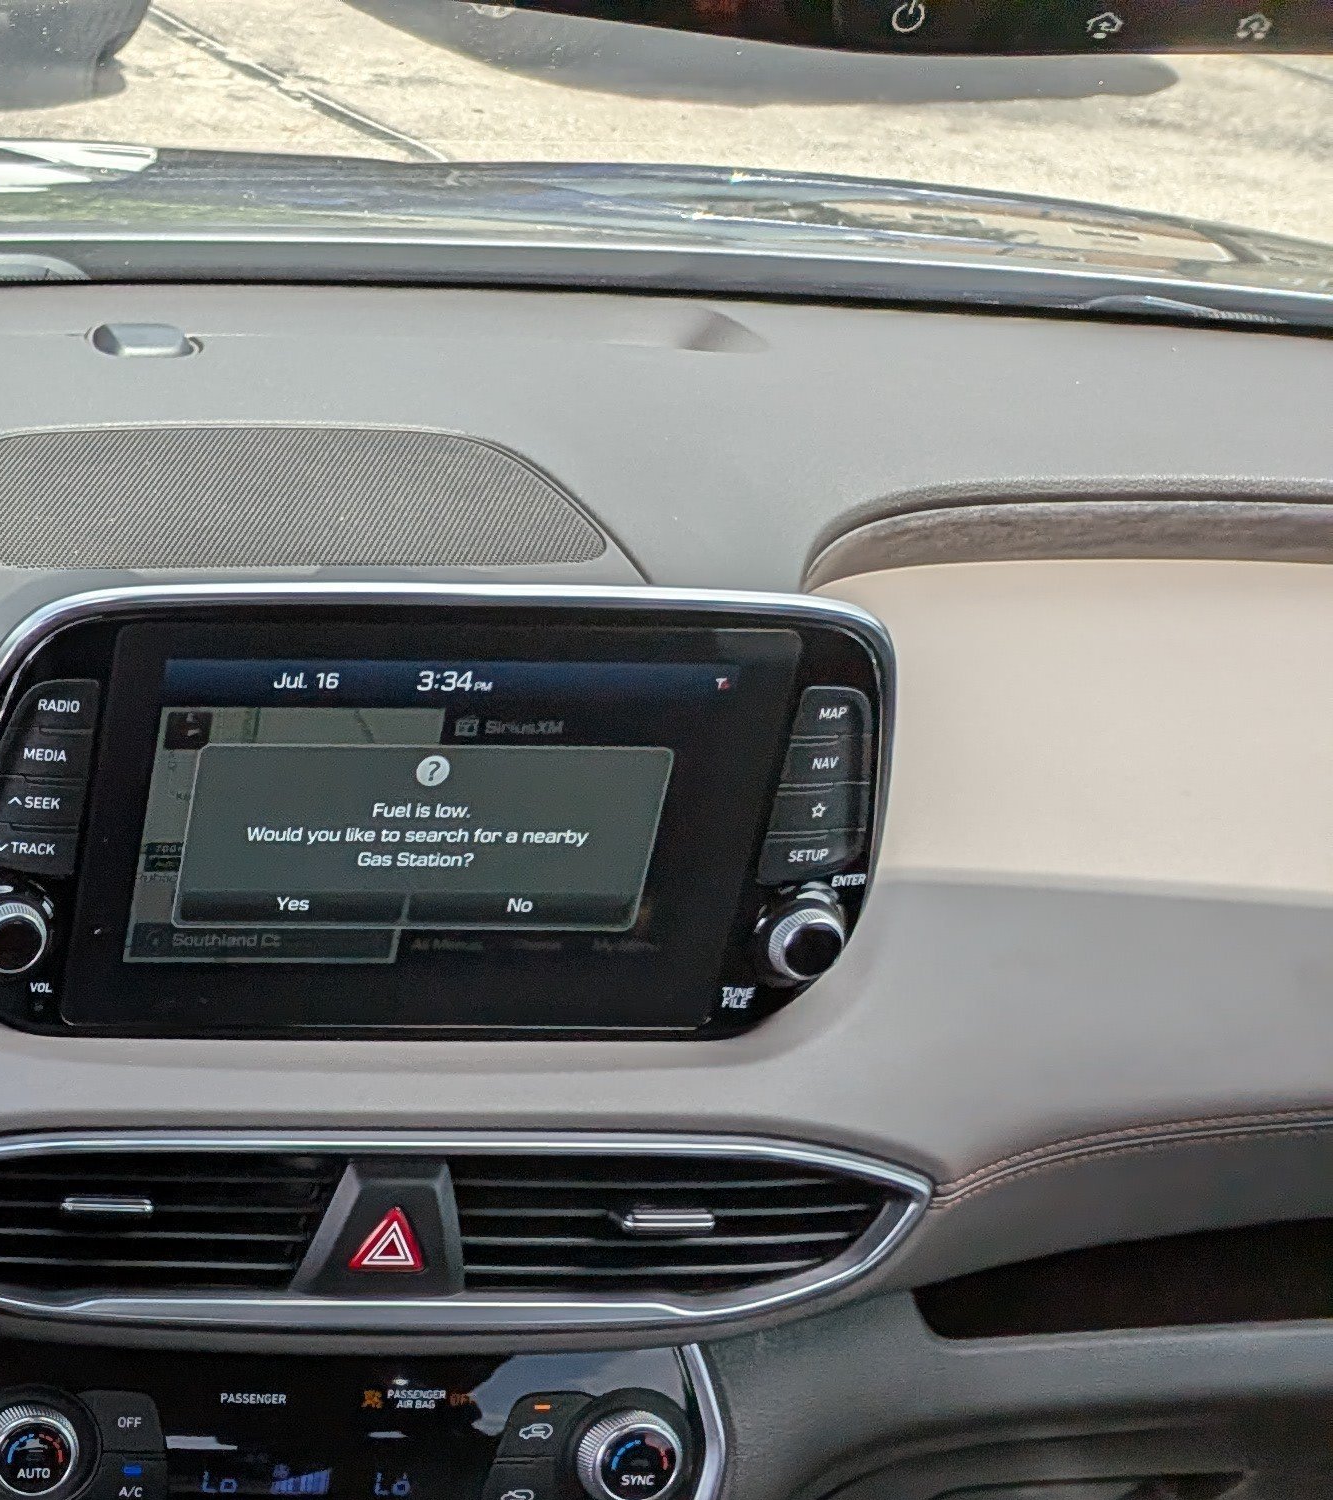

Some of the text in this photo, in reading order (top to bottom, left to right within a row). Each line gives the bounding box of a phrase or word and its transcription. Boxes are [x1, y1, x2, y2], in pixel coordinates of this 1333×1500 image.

[315, 673, 340, 689] 16
[37, 698, 81, 714] RADIO
[818, 707, 848, 720] MAP
[23, 747, 67, 763] MEDIA
[811, 756, 840, 771] NAV
[24, 796, 61, 810] SEEK
[372, 803, 472, 819] Fuel is low.
[246, 826, 590, 848] Would you like to search for a nearby
[11, 841, 56, 856] TRACK
[357, 851, 475, 868] Gas Station?
[787, 848, 830, 864] SETUP
[831, 873, 867, 887] ENTER
[276, 897, 310, 912] Yes
[506, 898, 533, 914] No
[29, 982, 53, 994] VOL
[721, 986, 755, 999] TUNE
[720, 997, 751, 1009] FILE
[219, 1392, 287, 1405] PASSENGER
[386, 1389, 447, 1400] PASSENGER
[396, 1399, 436, 1409] AIR BAG
[117, 1416, 142, 1429] OFF
[16, 1467, 52, 1480] AUTO
[620, 1474, 656, 1487] SYNC
[118, 1486, 143, 1499] A/C
